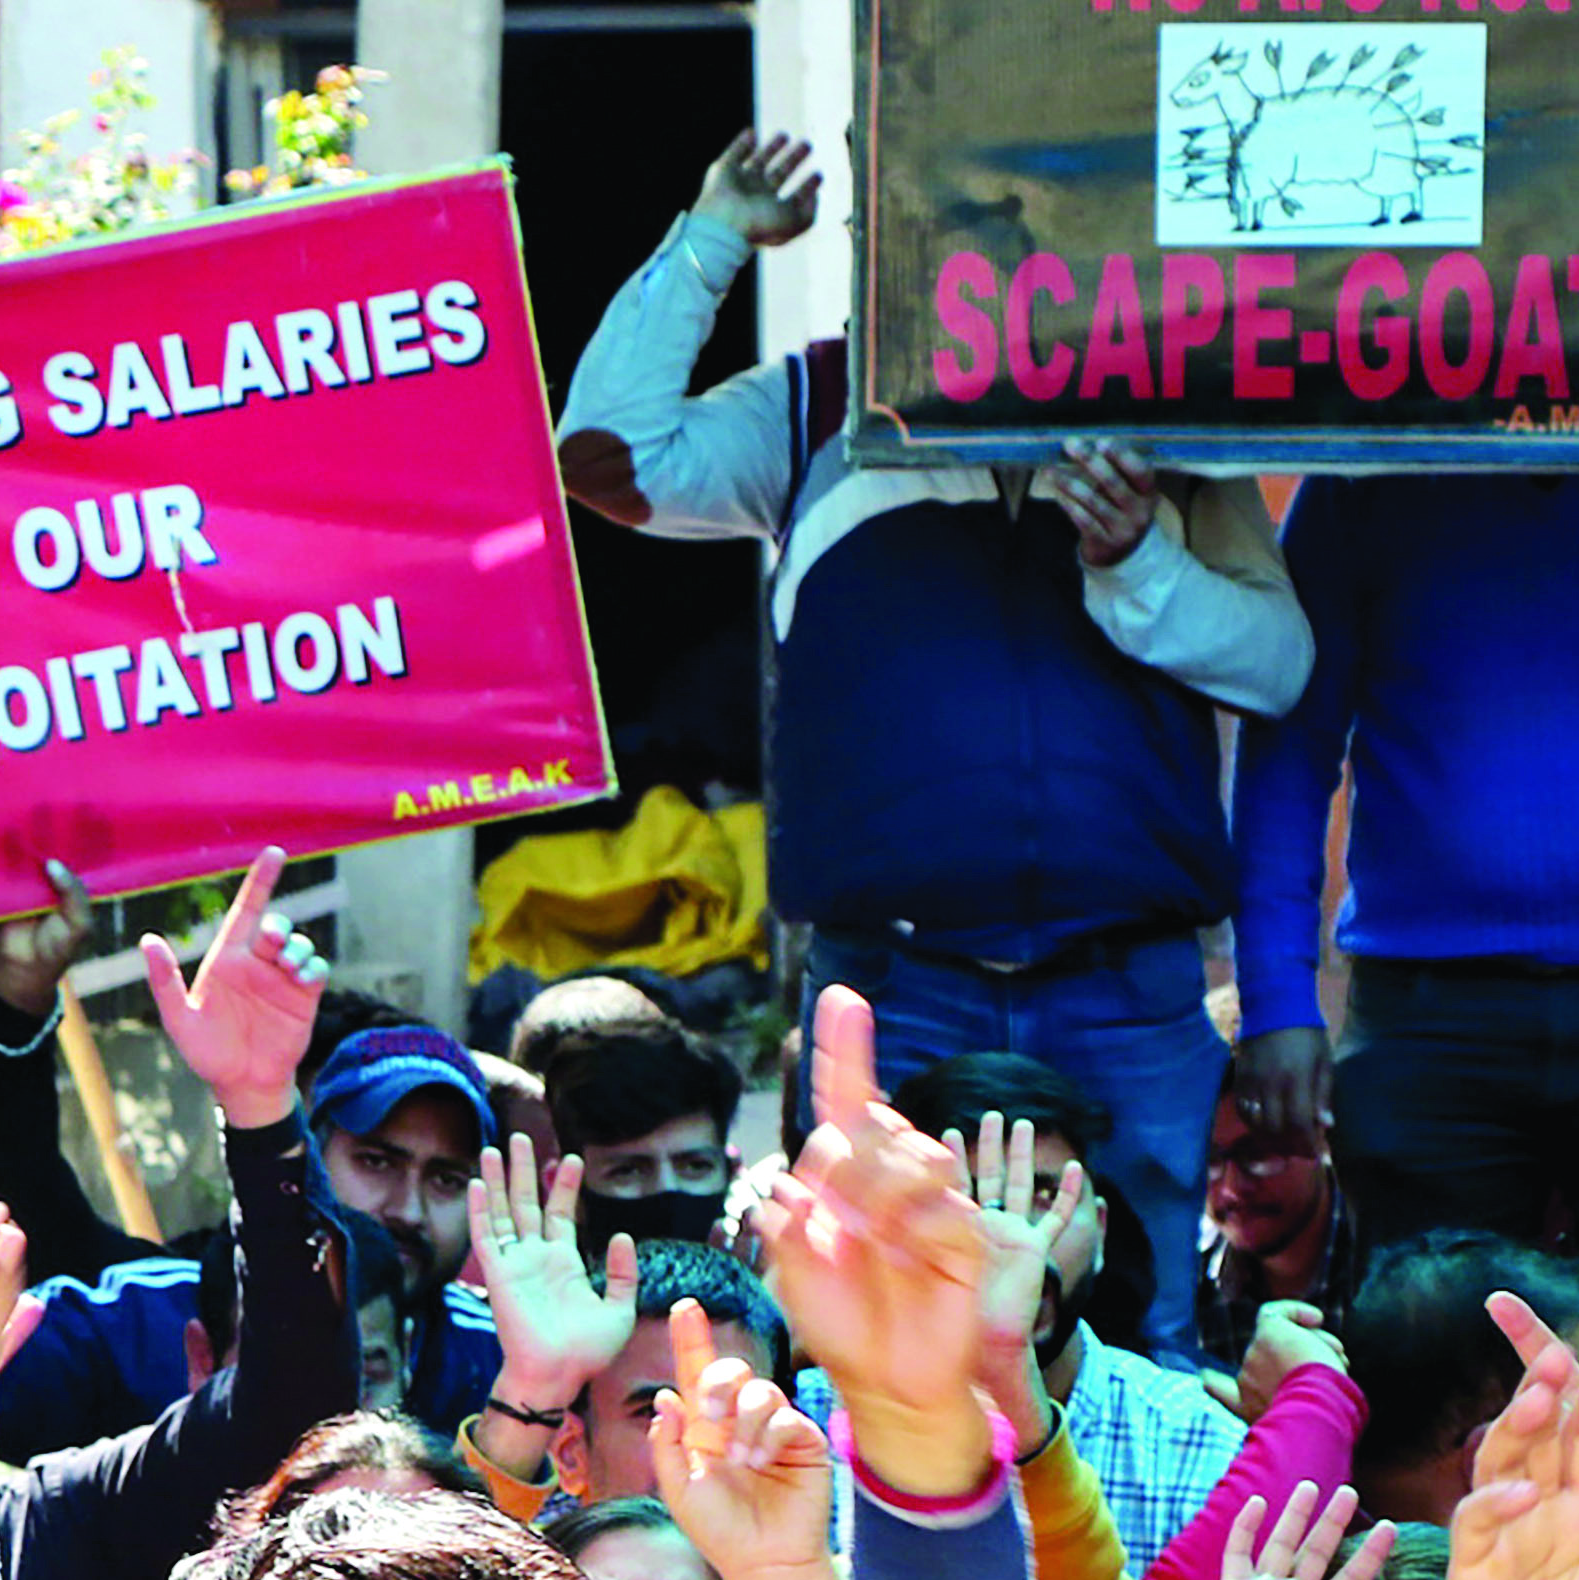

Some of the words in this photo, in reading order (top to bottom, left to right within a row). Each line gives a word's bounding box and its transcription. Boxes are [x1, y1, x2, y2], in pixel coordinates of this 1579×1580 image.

[43, 281, 487, 437] SALARIES
[13, 485, 219, 593] OUR
[392, 760, 575, 820] A.M.E.A.K
